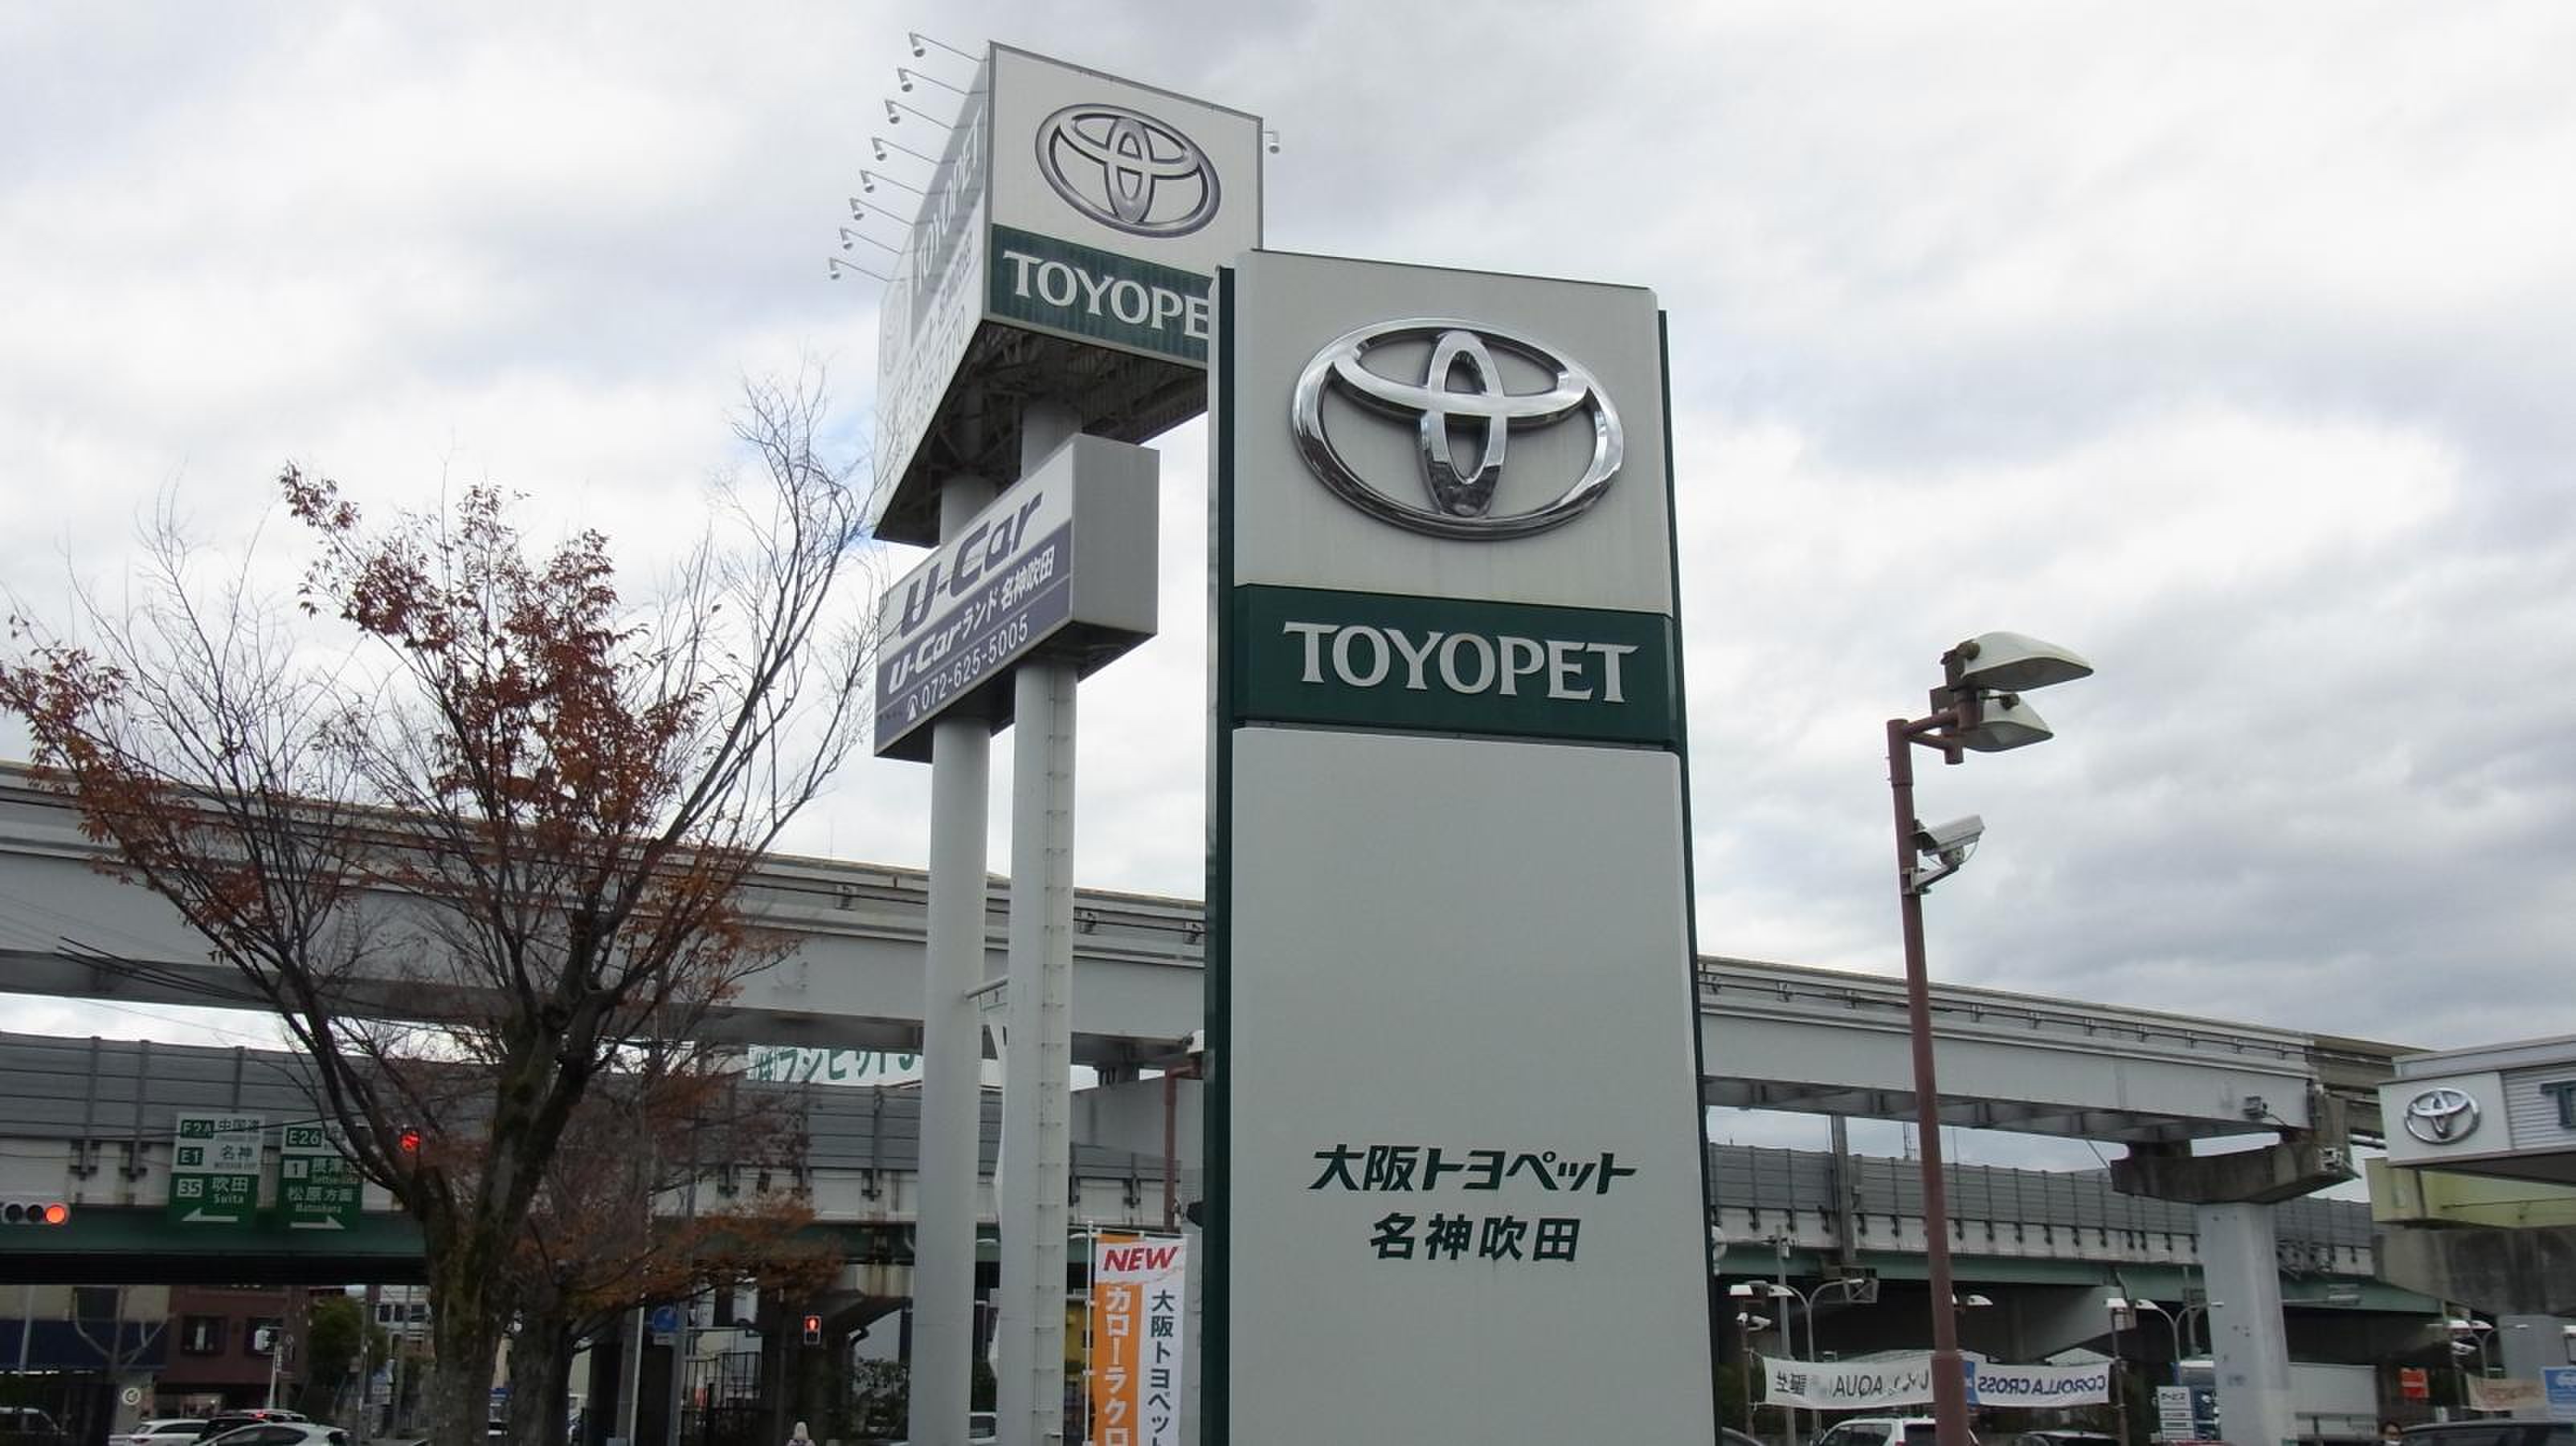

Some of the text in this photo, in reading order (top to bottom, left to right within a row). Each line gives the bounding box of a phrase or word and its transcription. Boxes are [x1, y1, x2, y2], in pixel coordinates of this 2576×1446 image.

[901, 491, 1042, 639] U-Car
[922, 614, 1028, 710] 072-625-5005
[1284, 621, 1638, 703] TOYOPET
[289, 1130, 320, 1145] E26
[180, 1150, 200, 1164] E1
[222, 1144, 253, 1160] 名神
[1308, 1143, 1638, 1195] 大阪トヨペット
[179, 1181, 200, 1195] 35
[211, 1176, 248, 1193] 吹田
[1370, 1212, 1581, 1261] 名神吹田
[1104, 1246, 1178, 1272] NEW
